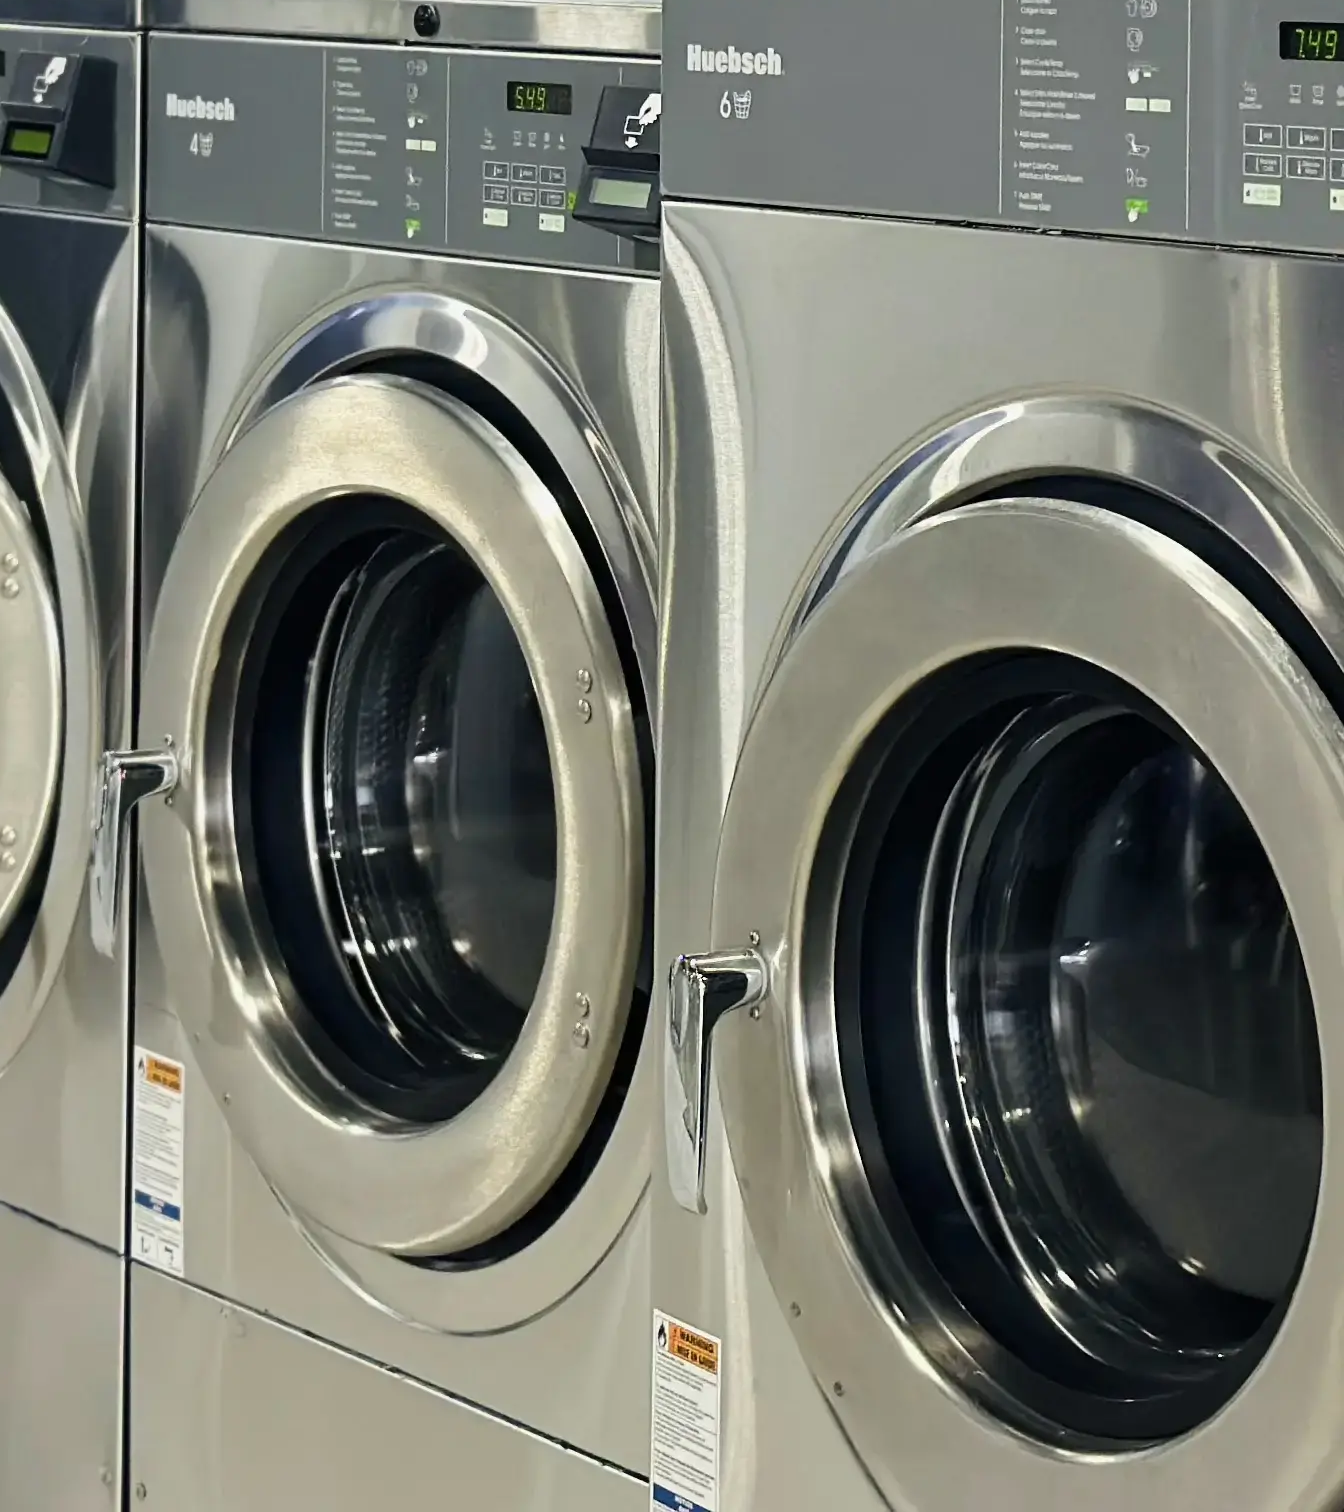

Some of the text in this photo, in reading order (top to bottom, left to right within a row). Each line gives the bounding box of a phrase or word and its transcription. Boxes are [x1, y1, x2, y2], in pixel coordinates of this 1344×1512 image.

[687, 43, 782, 76] Huebsch
[166, 92, 235, 121] Huebsch
[720, 90, 731, 119] 6
[189, 132, 198, 156] 4
